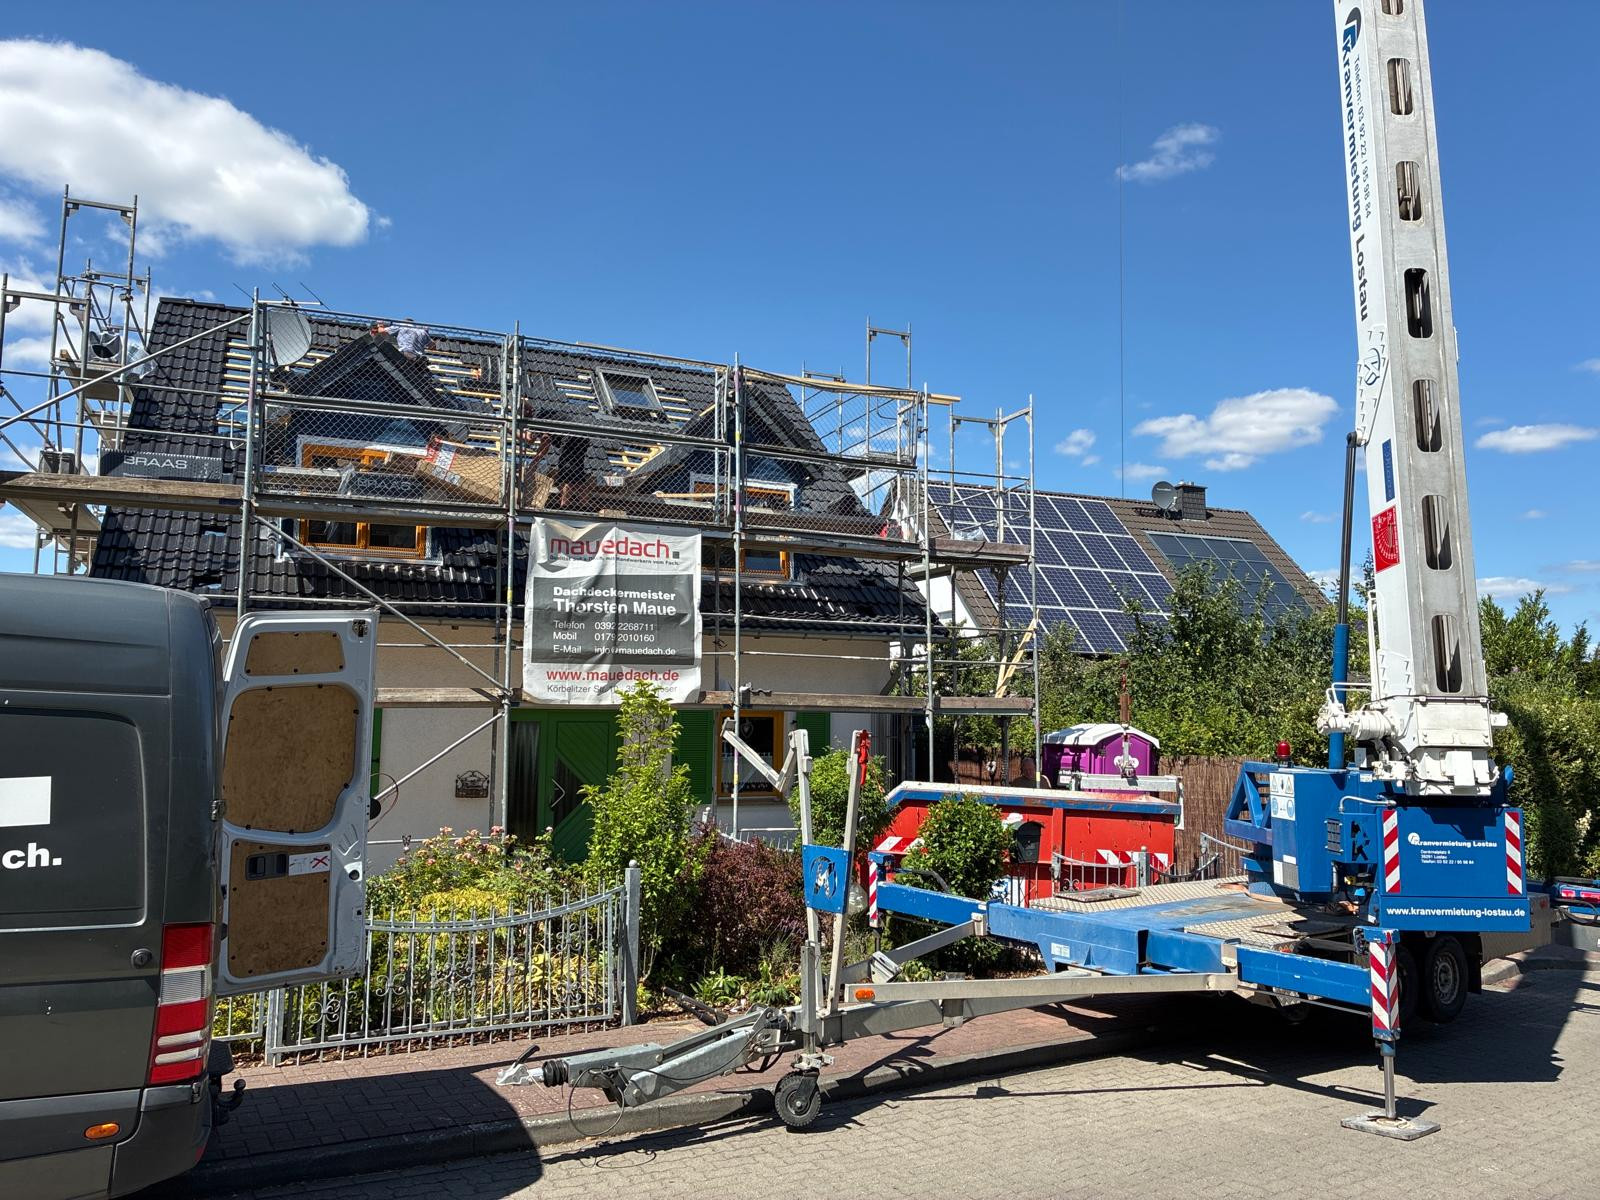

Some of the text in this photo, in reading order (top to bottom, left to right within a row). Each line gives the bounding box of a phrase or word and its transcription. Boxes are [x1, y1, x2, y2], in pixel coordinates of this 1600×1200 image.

[1358, 106, 1365, 122] 03
[1361, 140, 1367, 158] 22
[1342, 39, 1369, 322] Kranvermietung Lostau
[123, 455, 188, 469] BRAAS
[553, 586, 676, 601] Dachdeckermeister
[553, 598, 677, 616] Thorsten Maue
[554, 620, 585, 630] Telefon
[553, 631, 577, 640] Mobil
[553, 644, 582, 654] E-Mail
[546, 669, 680, 681] www.mauedach.de
[547, 684, 591, 693] Körbelitzer
[1473, 840, 1498, 848] Lostau
[1386, 906, 1526, 918] www.kranvermietung-lostau.de
